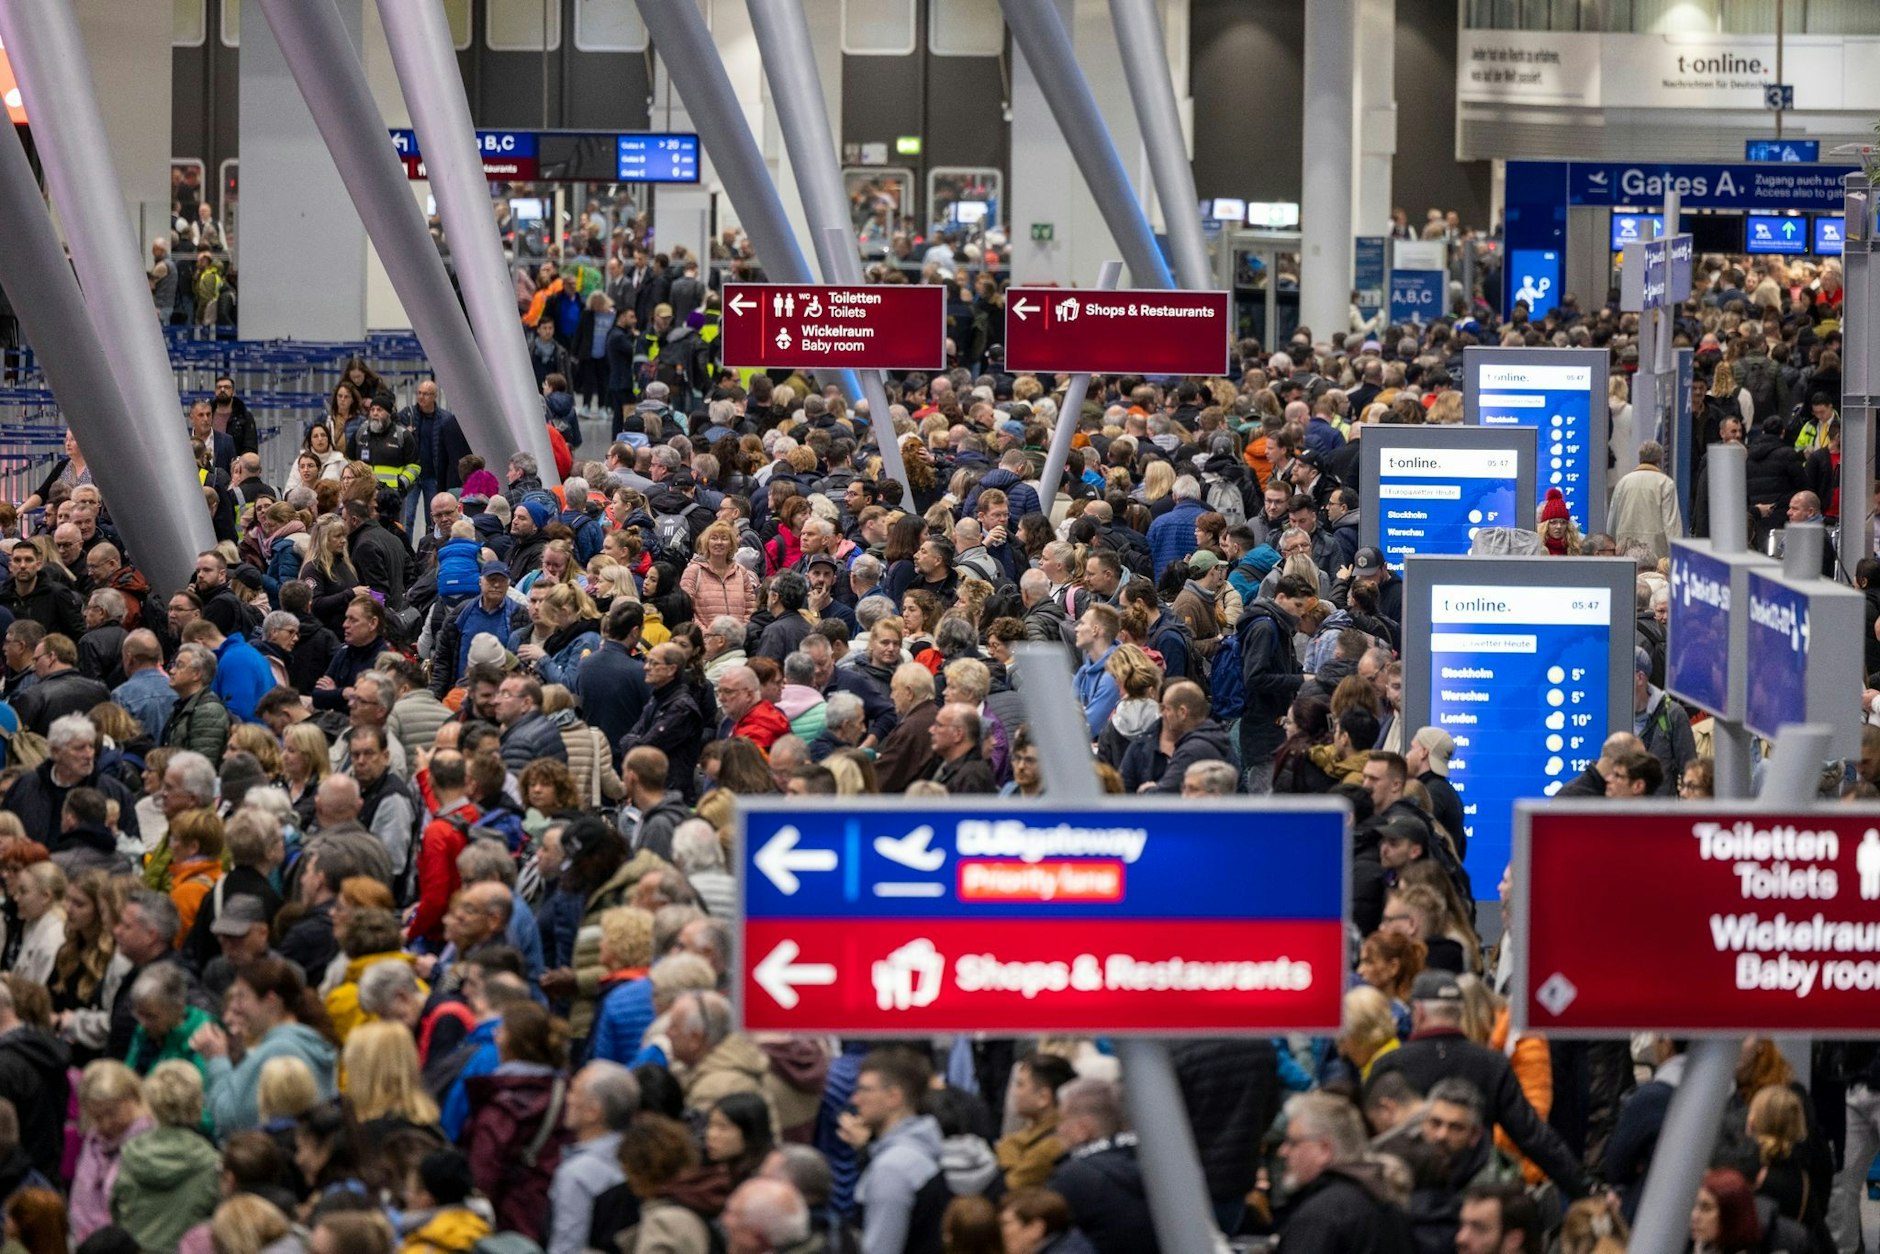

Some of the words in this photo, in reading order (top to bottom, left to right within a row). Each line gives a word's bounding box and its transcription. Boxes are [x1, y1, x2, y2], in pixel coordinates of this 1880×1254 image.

[1678, 53, 1769, 74] t-online.
[485, 134, 515, 153] B,C
[1621, 169, 1707, 197] Gates
[1754, 173, 1794, 188] Zugang
[1796, 174, 1822, 187] auch
[1823, 176, 1835, 186] zu
[1754, 187, 1791, 198] Access
[1792, 187, 1813, 198] also
[1814, 189, 1825, 198] to
[828, 292, 881, 304] Toiletten
[828, 305, 866, 318] Toilets
[1085, 303, 1125, 318] Shops
[1128, 304, 1138, 316] &
[1140, 304, 1215, 318] Restaurants
[801, 325, 874, 337] Wickelraum
[801, 339, 831, 354] Baby
[834, 341, 865, 351] room
[1389, 457, 1442, 469] t-online.
[1387, 511, 1427, 519] Stockholm
[1387, 528, 1424, 537] Warschau
[1387, 545, 1415, 554] London
[1386, 563, 1404, 571] Berli
[1441, 667, 1494, 679] Stockholm
[1441, 690, 1489, 702] Warschau
[1441, 713, 1477, 724] London
[1692, 821, 1839, 861] Toiletten
[1733, 860, 1839, 900] Toilets
[1709, 912, 1880, 952] Wickelrau
[955, 952, 1069, 999] Shops
[1070, 953, 1103, 991] &
[1105, 953, 1312, 991] Restaurants
[1735, 951, 1820, 998] Baby
[1822, 959, 1880, 991] roo
